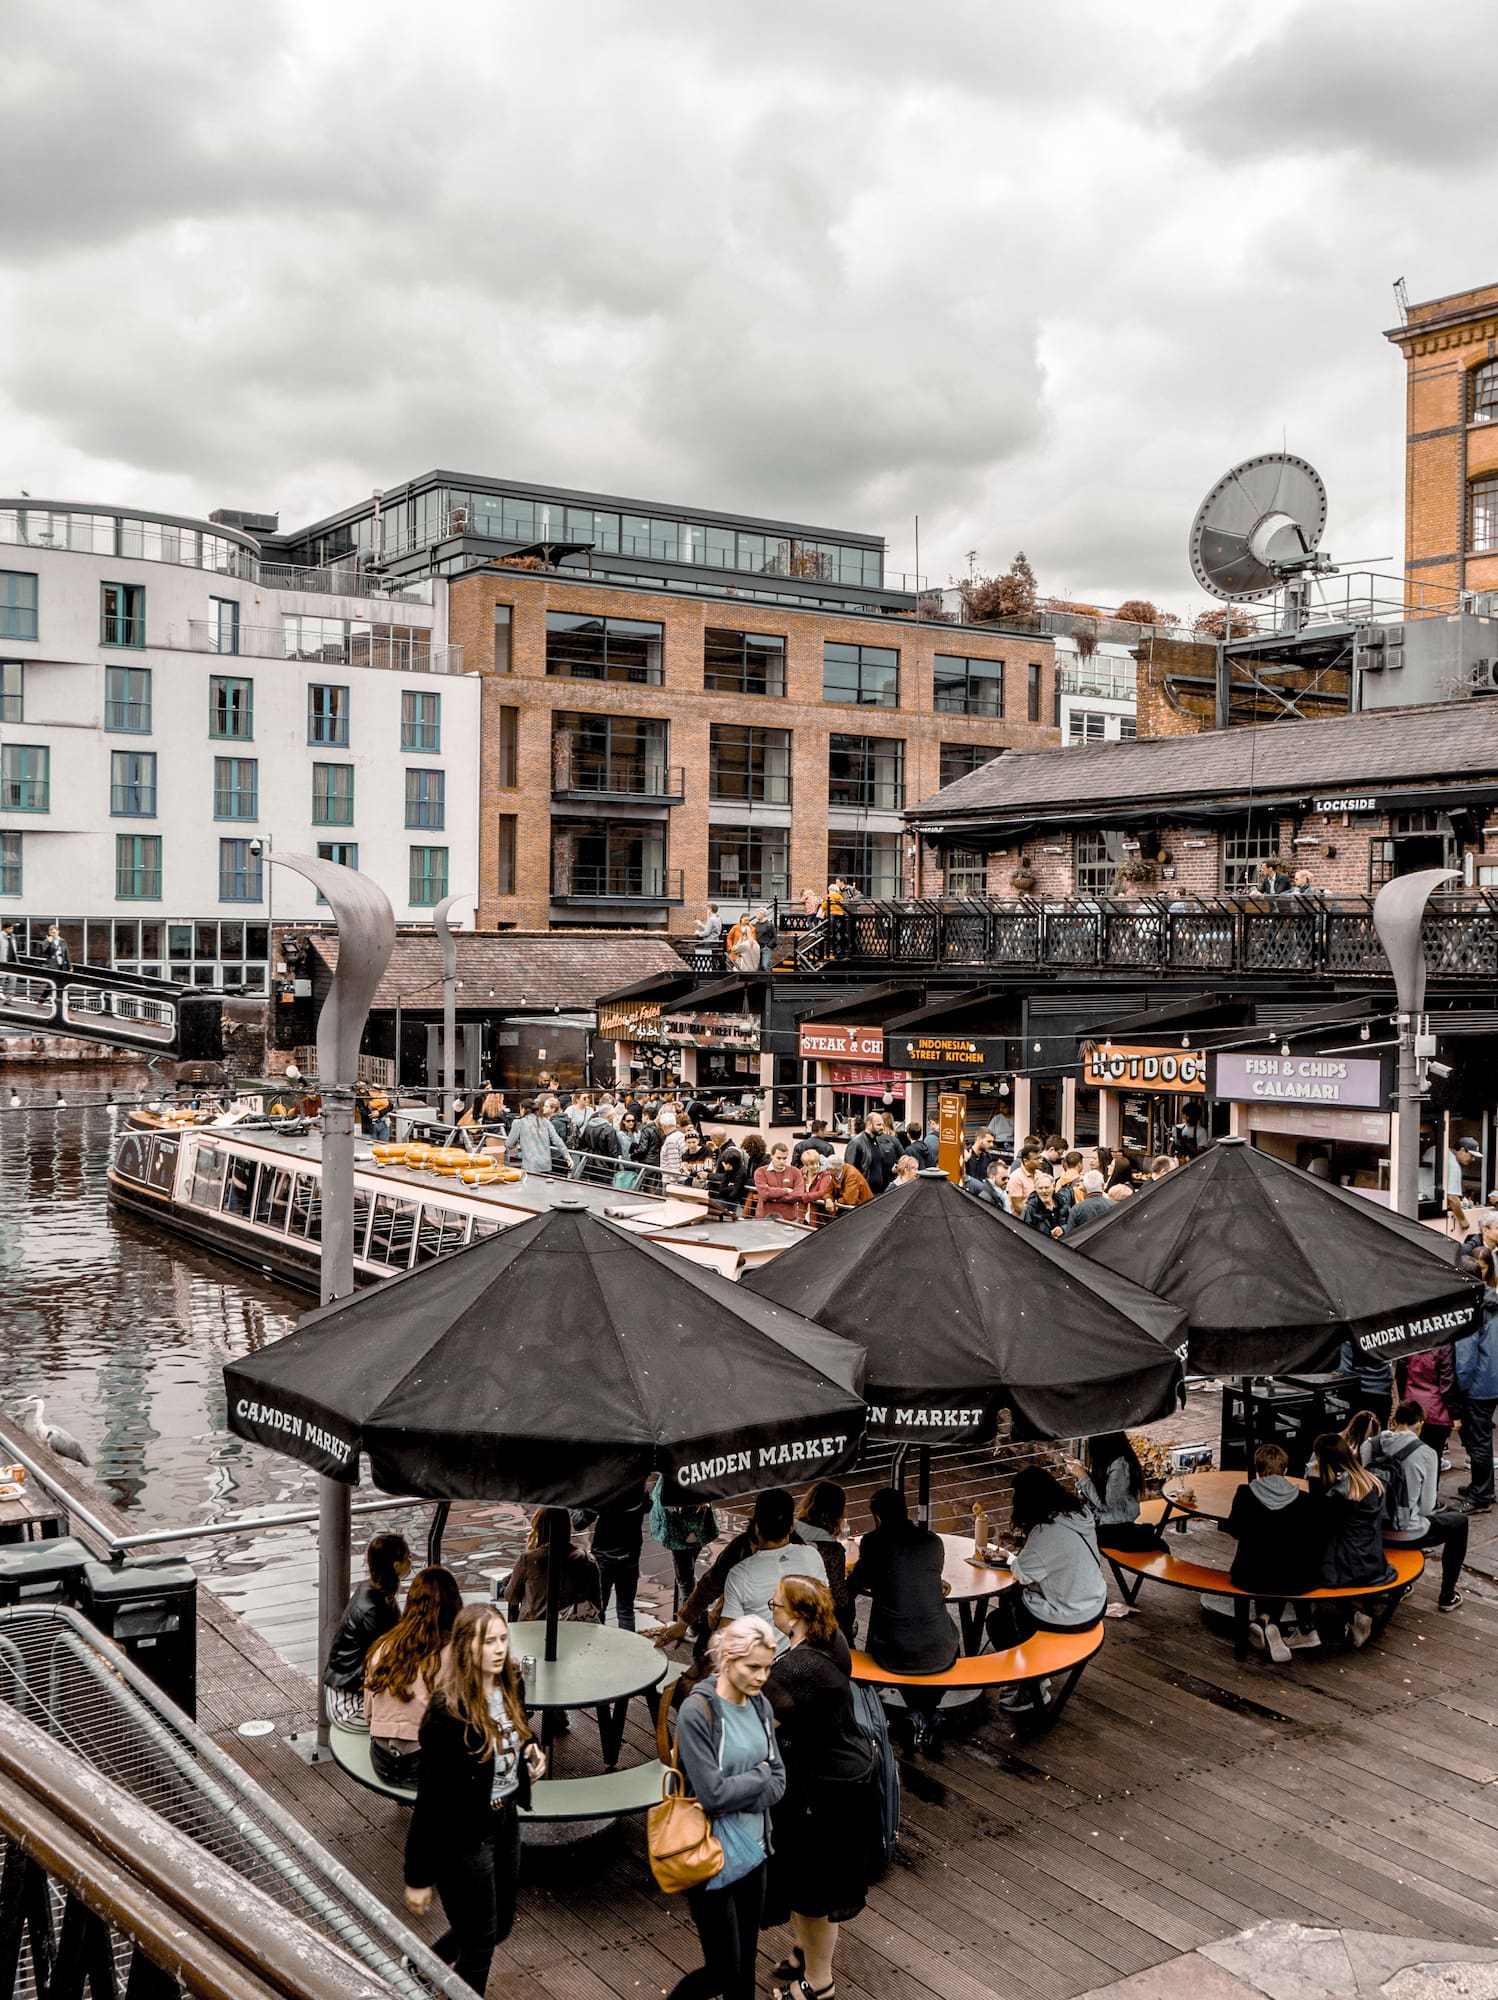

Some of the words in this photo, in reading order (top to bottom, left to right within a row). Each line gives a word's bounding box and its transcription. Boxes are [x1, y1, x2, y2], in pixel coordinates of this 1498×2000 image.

[1316, 799, 1376, 811] LOCKSIDE
[803, 1037, 847, 1052] STEAK
[850, 1041, 858, 1052] &
[911, 1050, 941, 1060] STREET
[945, 1052, 984, 1063] KITCHEN
[1246, 1059, 1279, 1075] FISH
[1283, 1061, 1295, 1076] &
[1299, 1062, 1347, 1079] CHIPS
[1253, 1081, 1339, 1100] CALAMARI
[1360, 1325, 1405, 1351] CAMDEN
[1408, 1308, 1474, 1337] MARKET
[895, 1409, 983, 1426] MARKET
[236, 1399, 302, 1437] CAMDEN
[305, 1422, 351, 1464] MARKET
[677, 1451, 751, 1486] CAMDEN
[759, 1435, 847, 1467] MARKET
